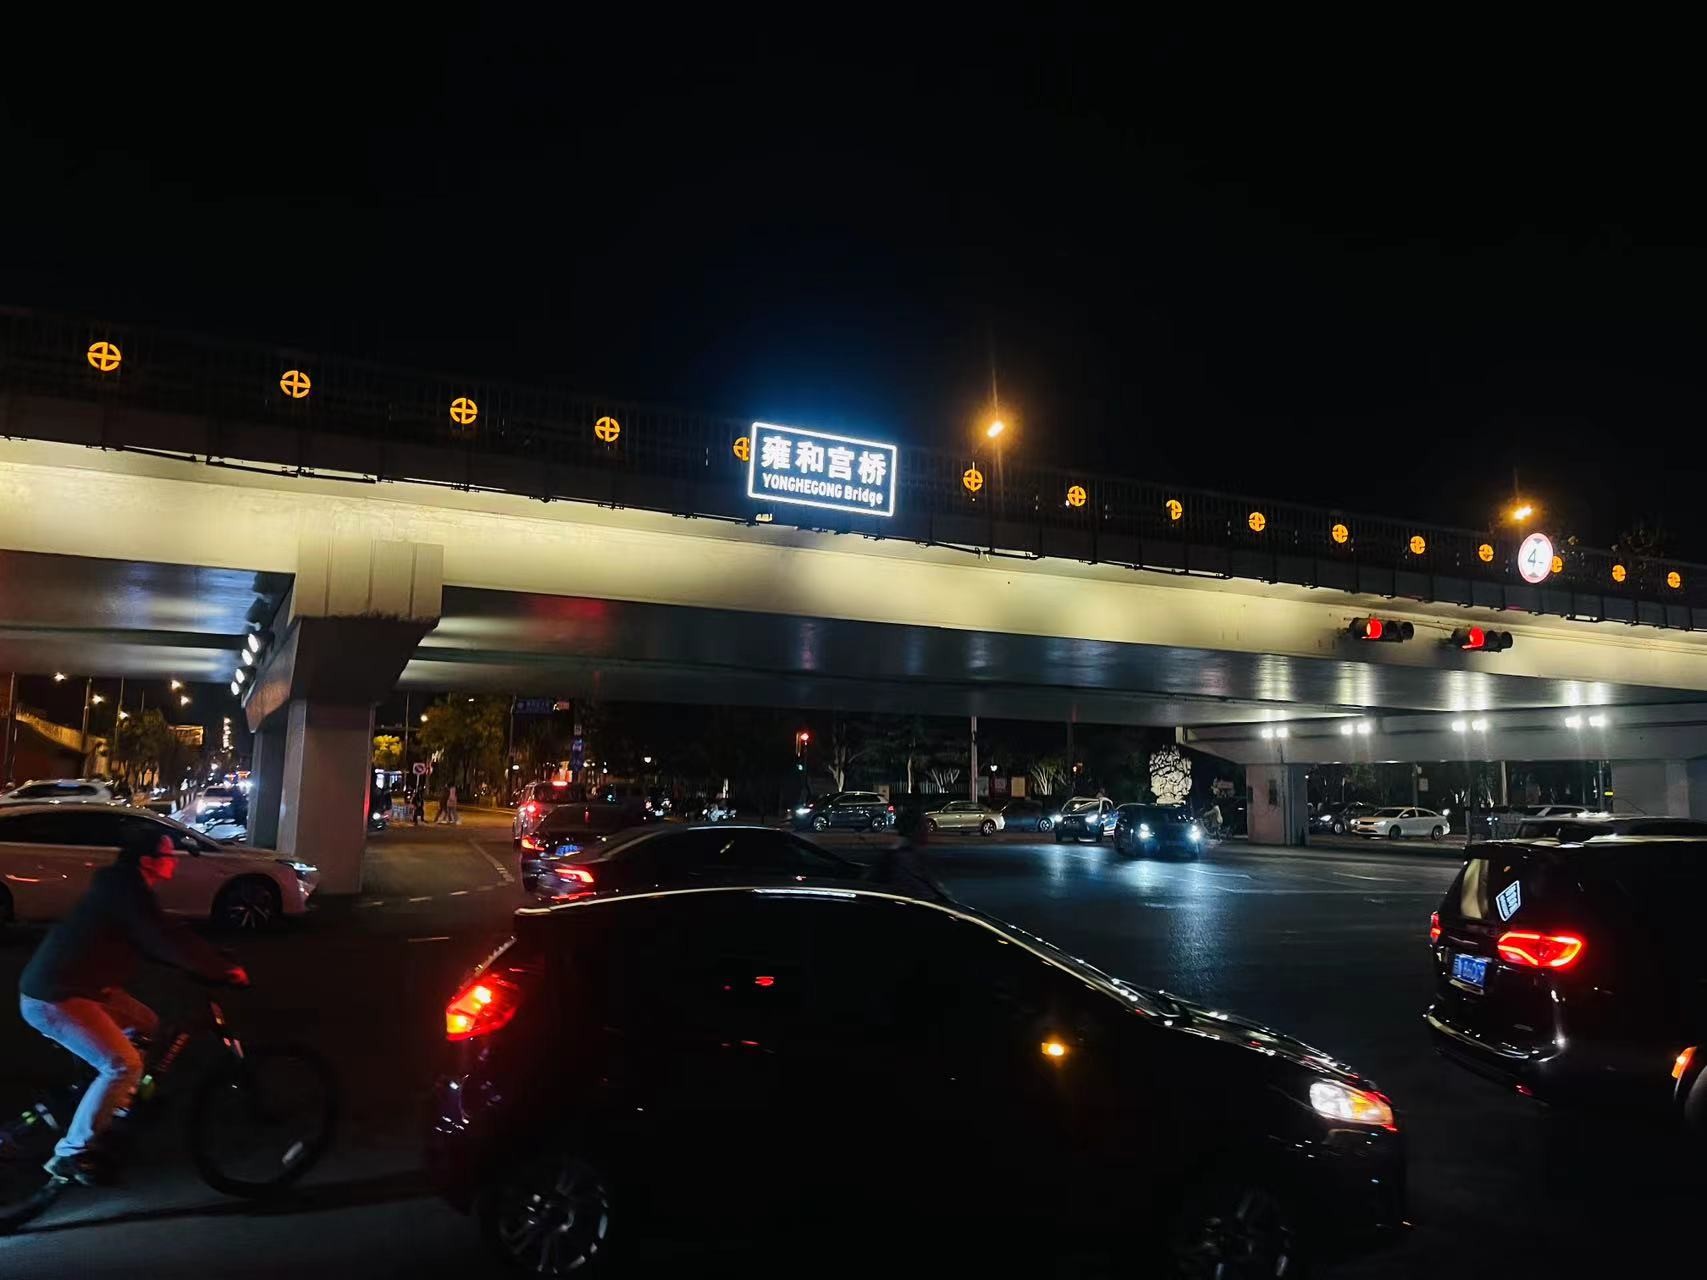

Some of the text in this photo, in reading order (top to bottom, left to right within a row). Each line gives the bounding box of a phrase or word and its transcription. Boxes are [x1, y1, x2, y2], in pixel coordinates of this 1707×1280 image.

[761, 436, 887, 485] 雍和宫桥
[762, 472, 884, 507] YONGHEGONG Bridge
